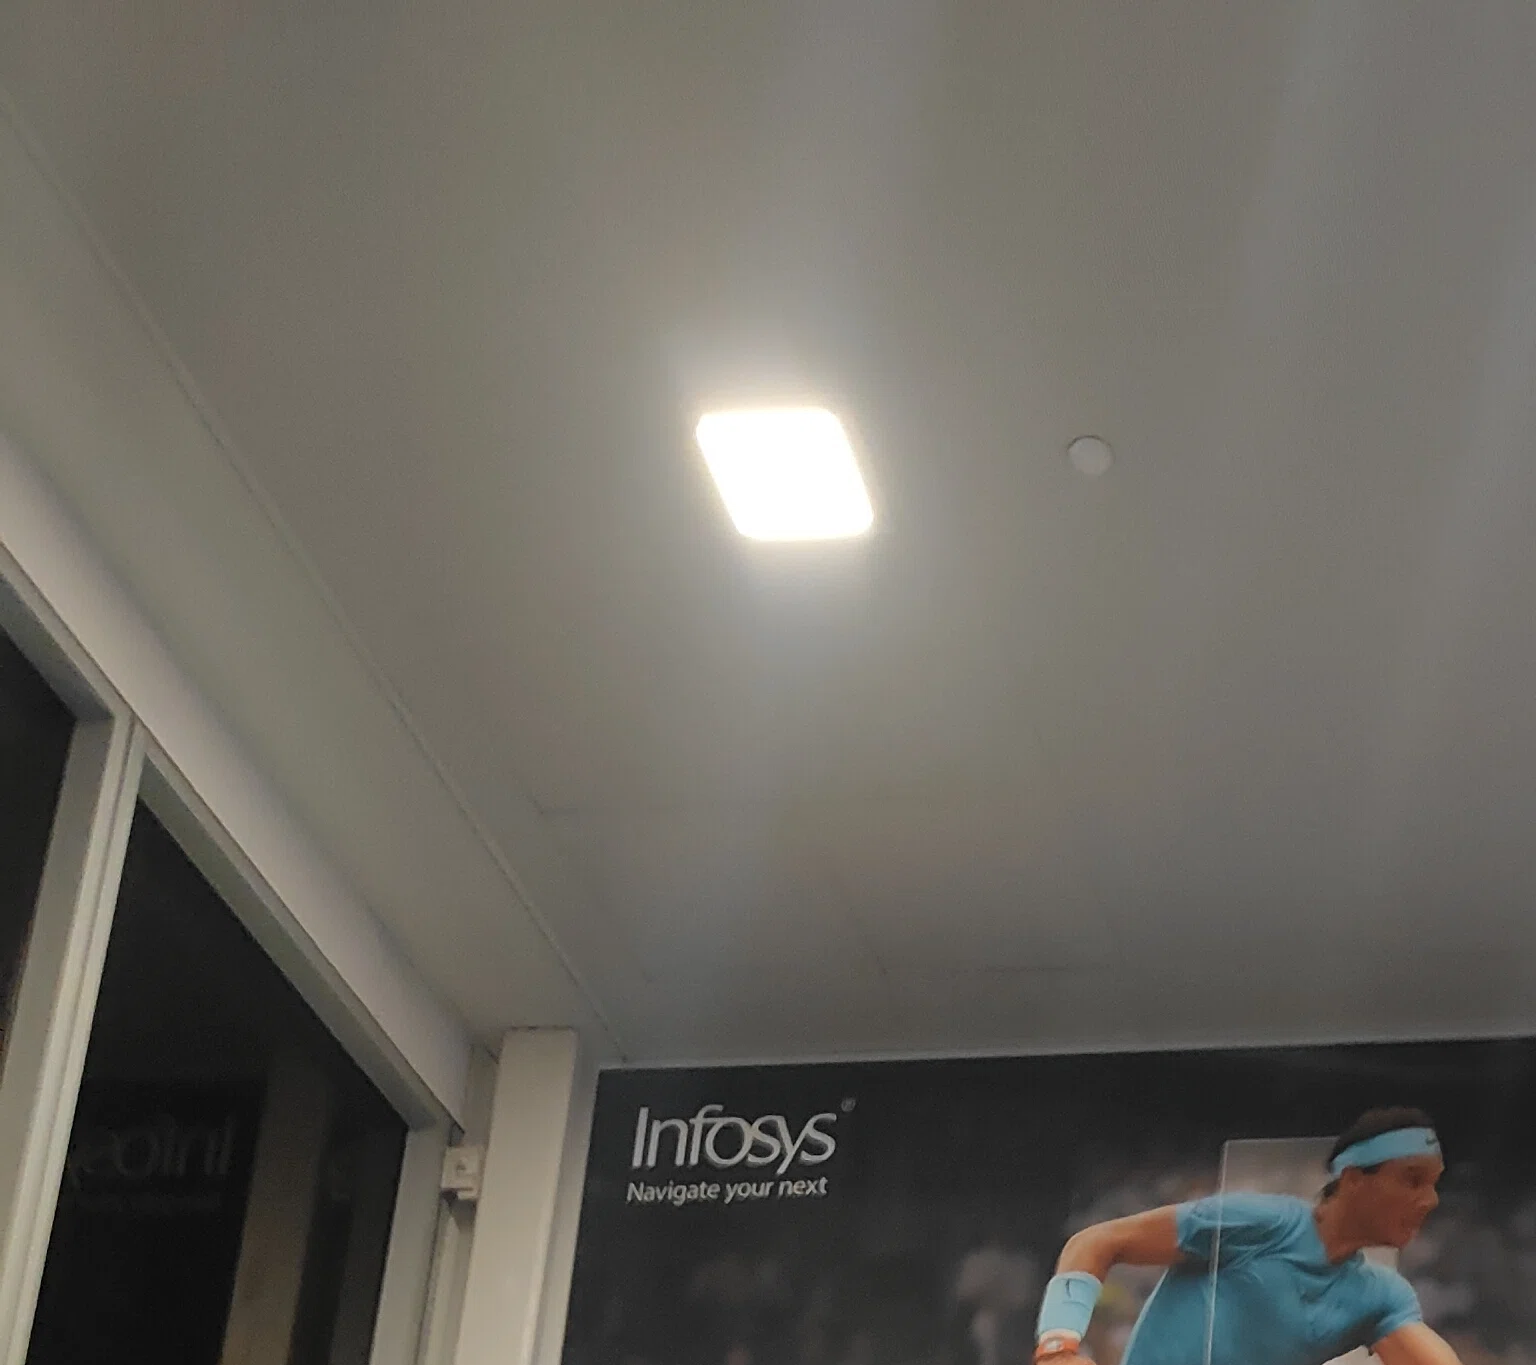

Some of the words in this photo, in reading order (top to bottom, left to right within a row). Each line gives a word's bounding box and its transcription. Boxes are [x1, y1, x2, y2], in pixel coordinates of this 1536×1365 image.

[632, 1103, 838, 1176] Infosys
[627, 1180, 721, 1207] Navigate
[724, 1179, 775, 1205] your
[778, 1176, 829, 1197] next
